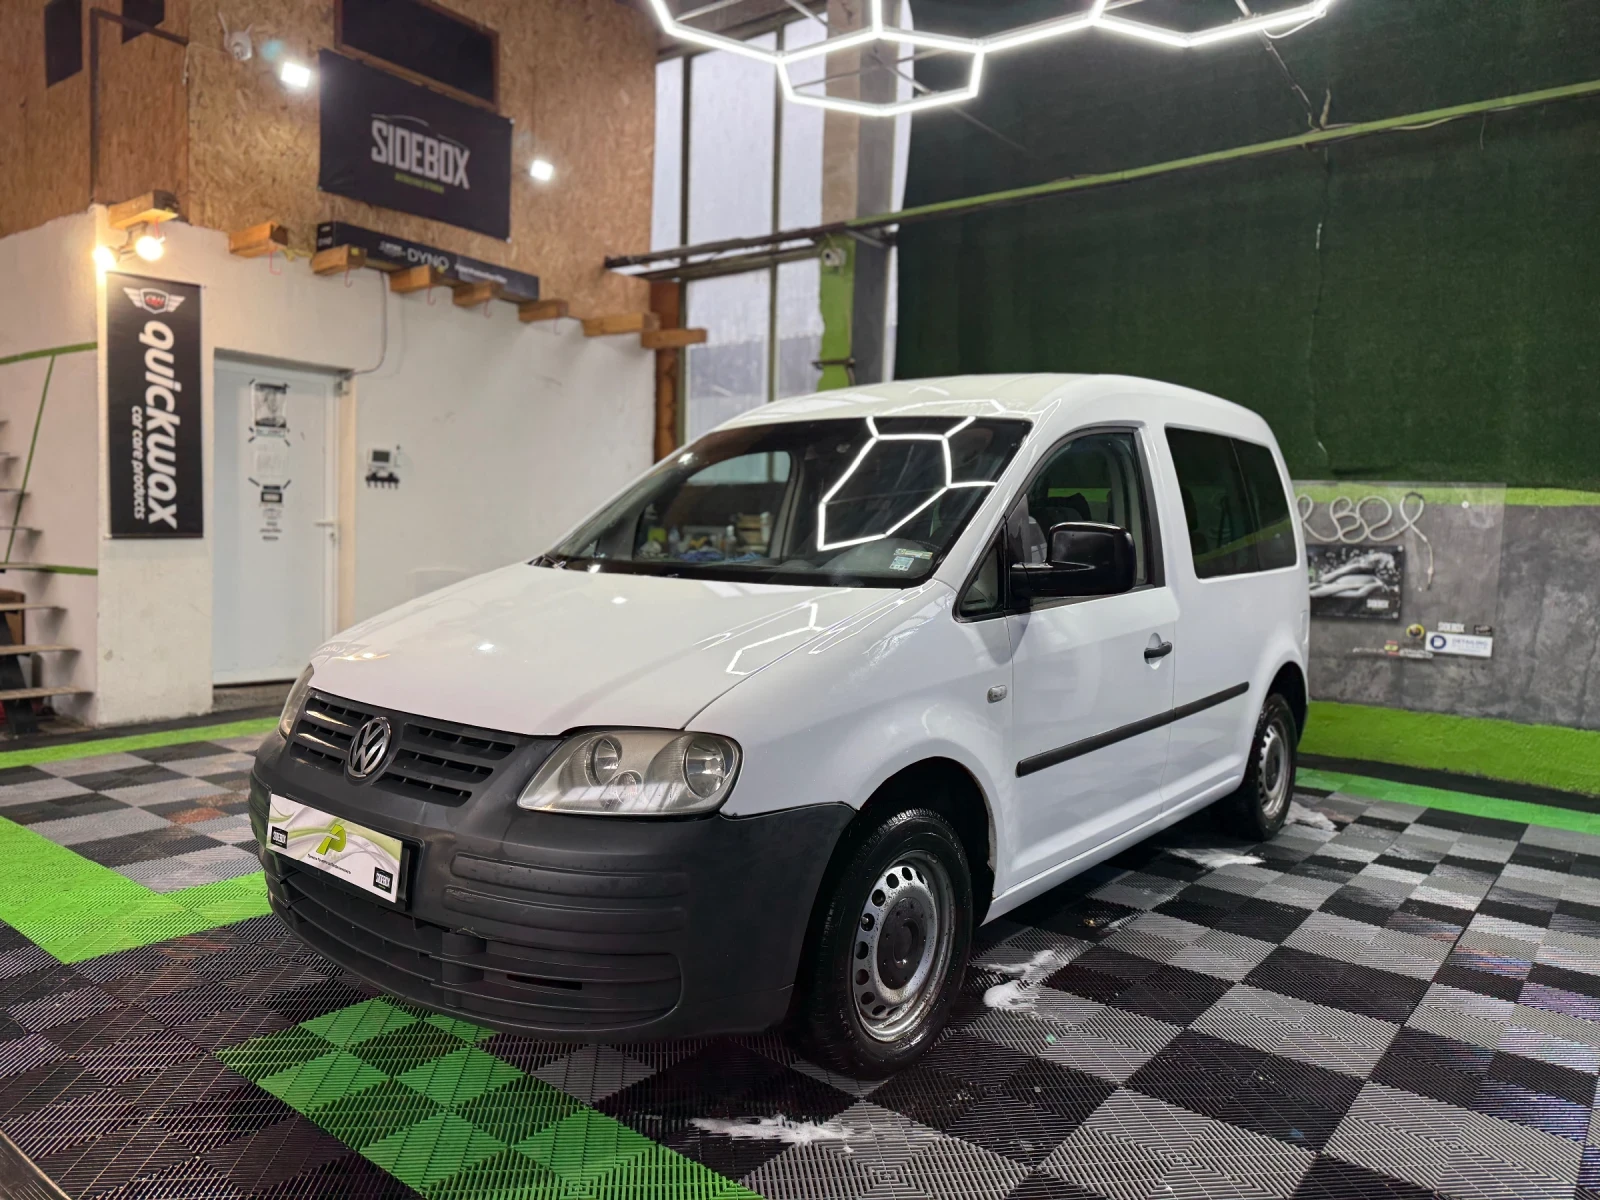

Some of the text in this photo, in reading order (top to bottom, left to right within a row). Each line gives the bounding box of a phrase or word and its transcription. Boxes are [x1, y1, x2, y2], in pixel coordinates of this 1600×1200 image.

[371, 119, 470, 190] SIDEBOX
[406, 247, 450, 271] DYNO
[131, 405, 146, 520] car care products
[138, 320, 182, 530] quickwax
